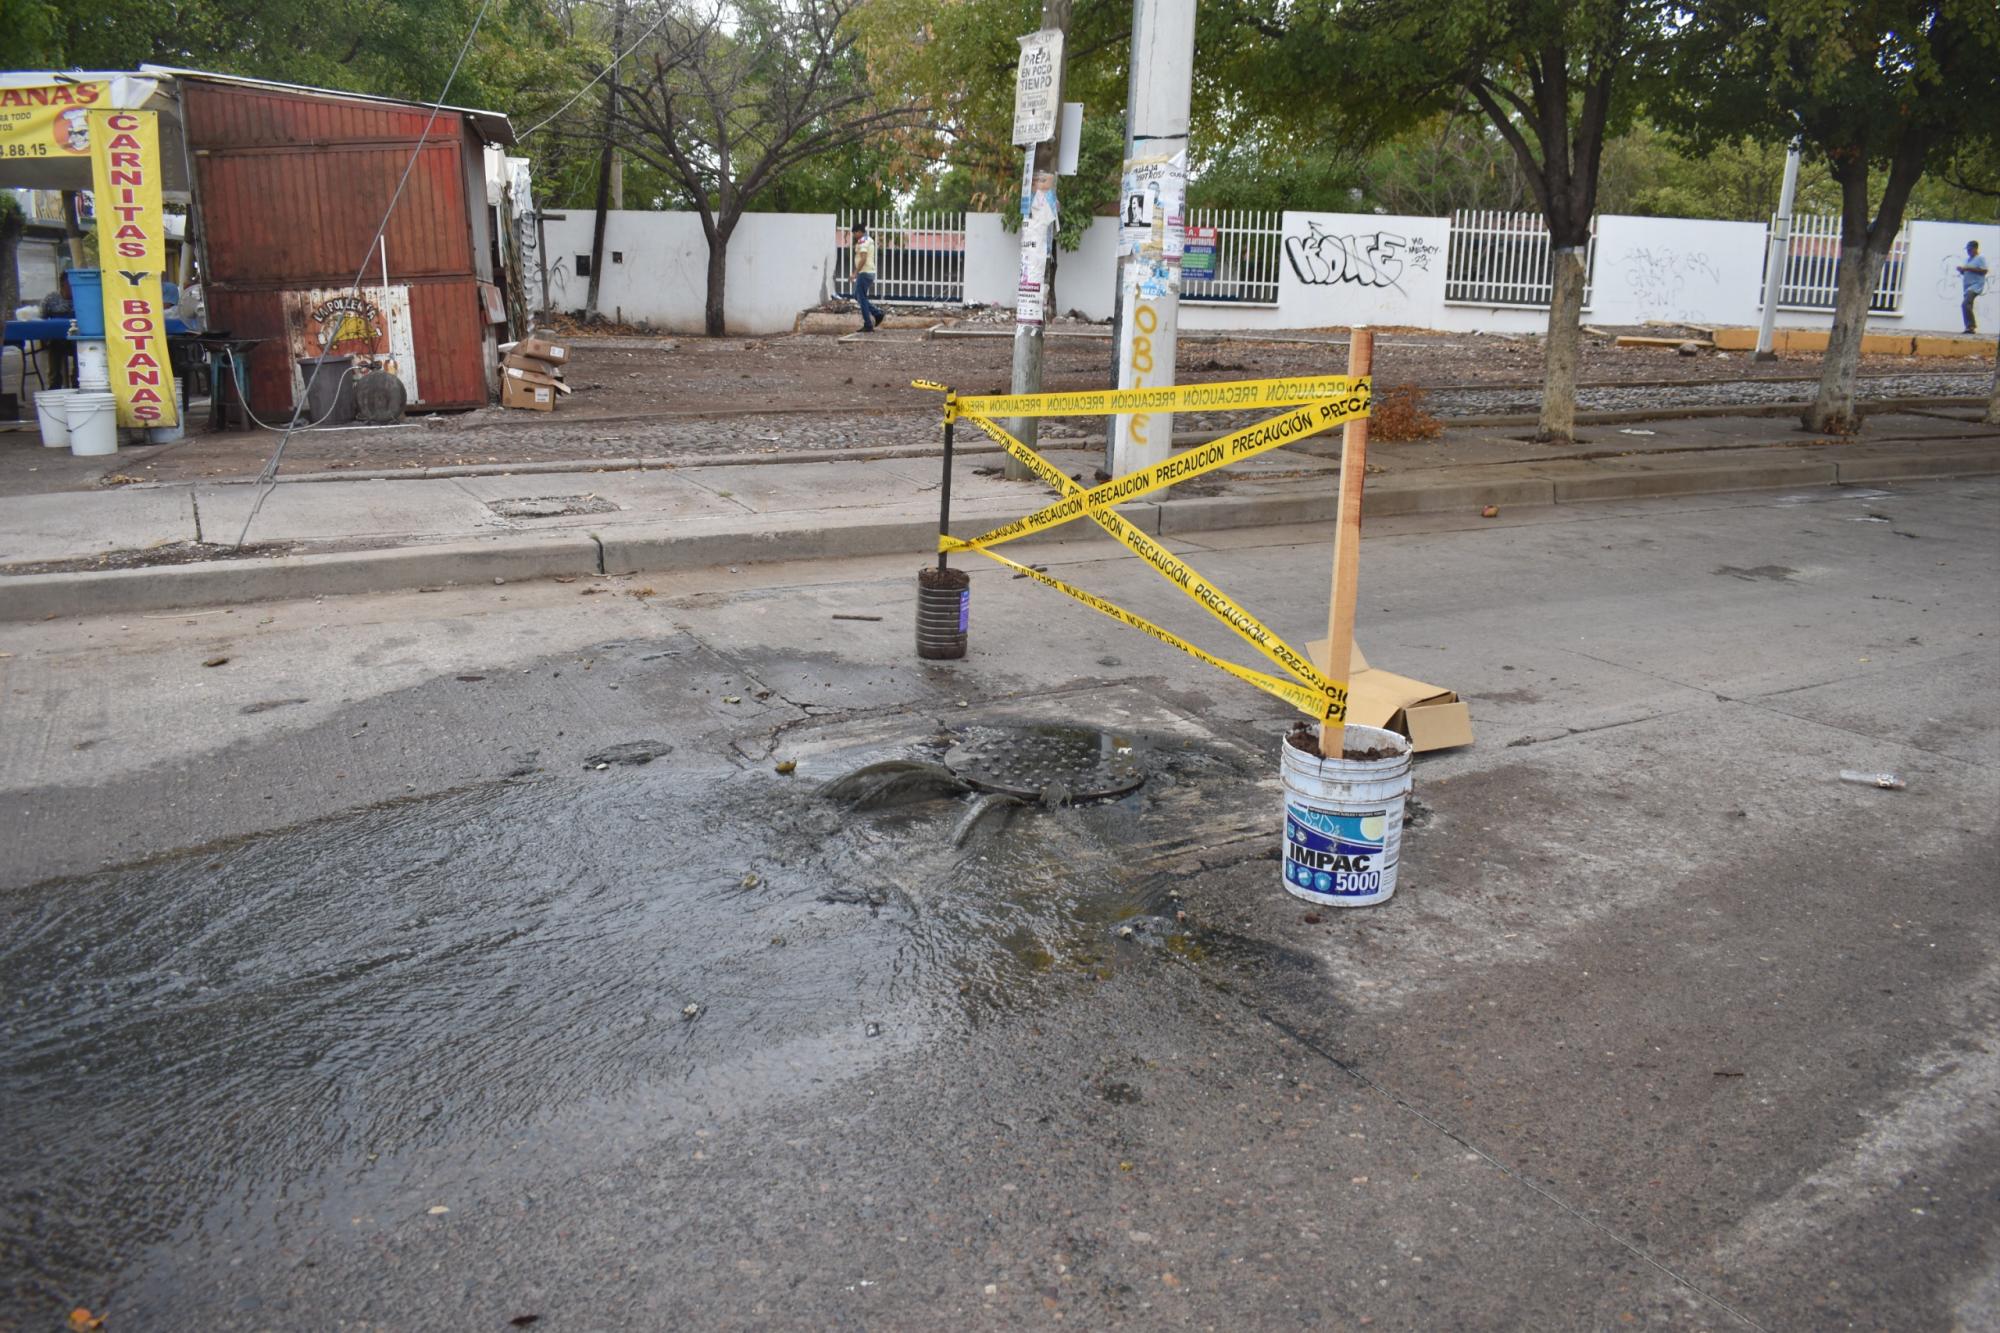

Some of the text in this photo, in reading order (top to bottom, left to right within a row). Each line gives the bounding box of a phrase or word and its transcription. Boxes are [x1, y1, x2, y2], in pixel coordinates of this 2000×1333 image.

[107, 115, 162, 421] CARNITAS Y BOTANAS
[1028, 497, 1083, 527] PRECAUCIÓN
[1088, 473, 1150, 507] PRECAUCIÓN
[1156, 444, 1225, 483] PRECAUCIÓN
[1232, 411, 1313, 456] PRECAUCIÓN
[1013, 446, 1066, 493] PRECAUCIÓN
[1127, 530, 1192, 588] PRECAUCIÓN
[1194, 583, 1270, 647] PRECAUCIÓN
[1290, 841, 1370, 873] IMPAC
[1336, 872, 1379, 892] 5000
